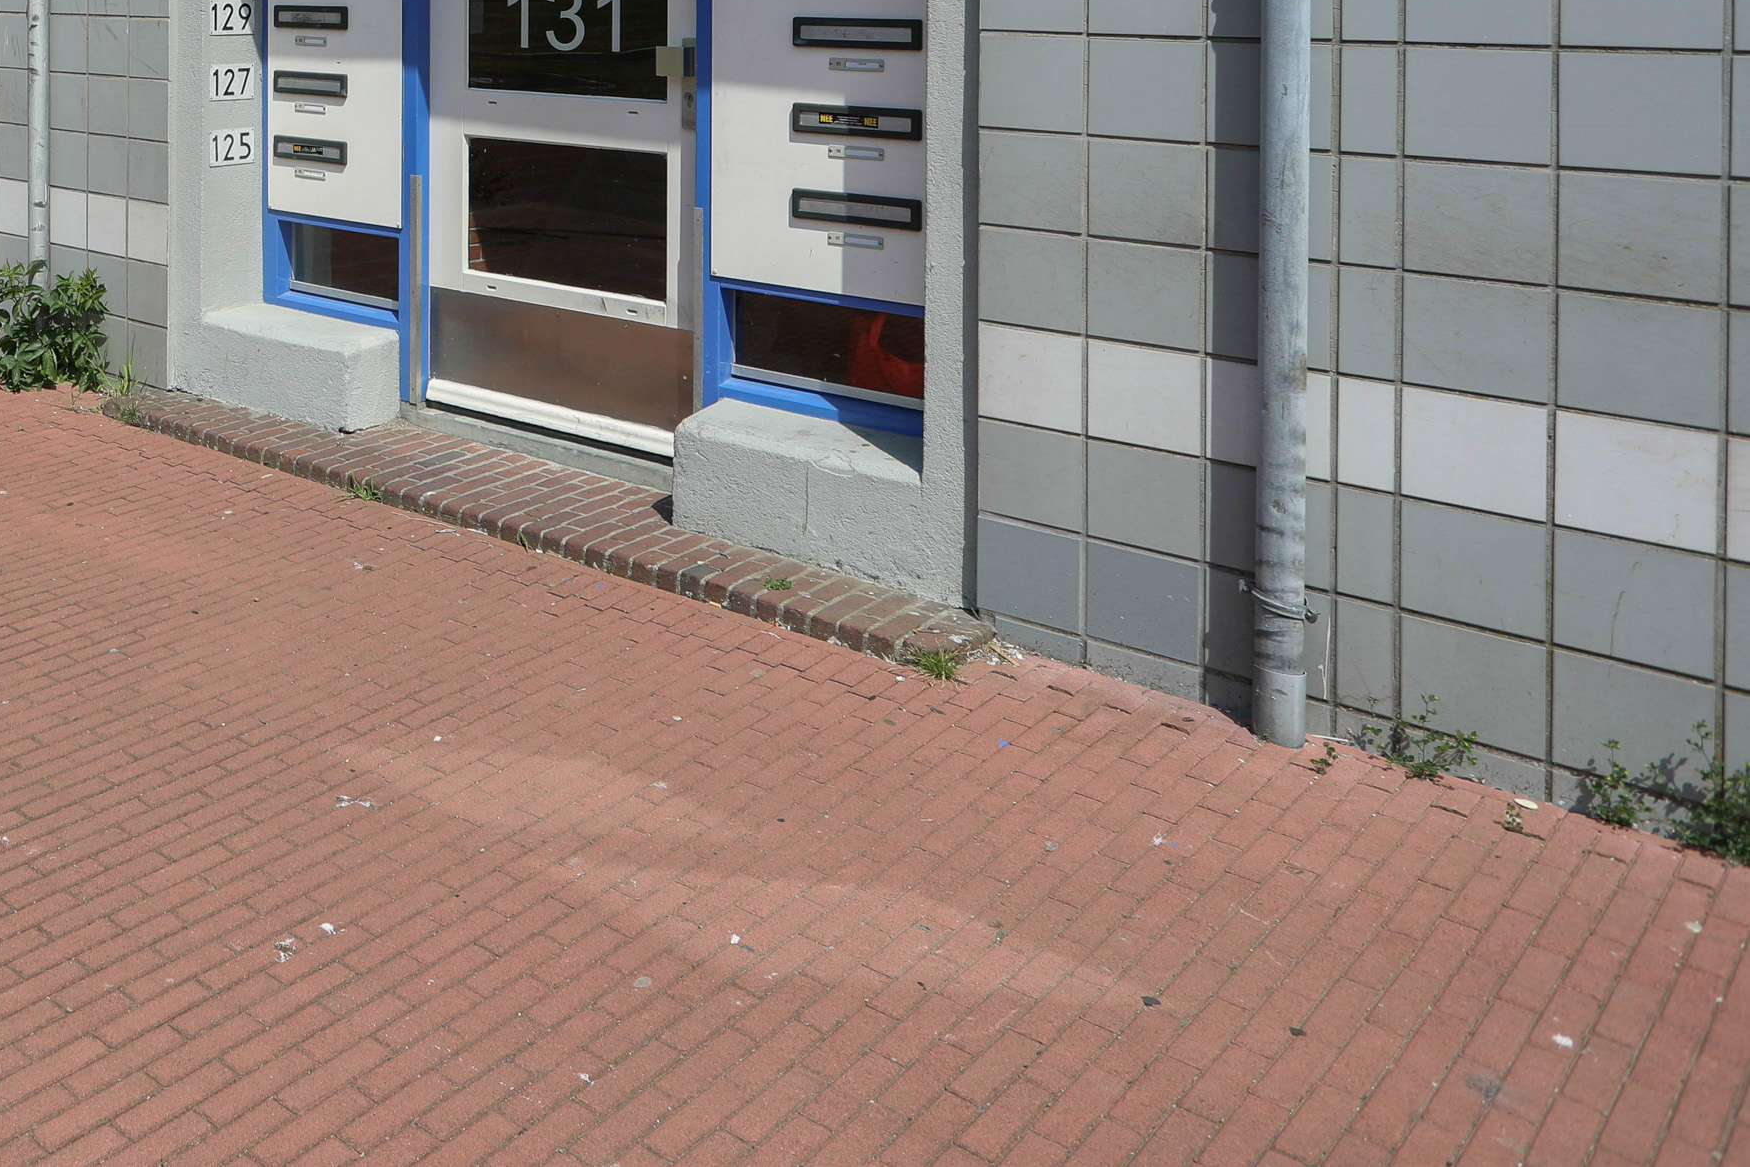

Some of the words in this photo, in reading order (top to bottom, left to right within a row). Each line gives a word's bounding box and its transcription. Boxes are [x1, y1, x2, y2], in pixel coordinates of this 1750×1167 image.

[211, 3, 252, 31] 129
[212, 68, 251, 96] 127
[820, 114, 833, 123] NEE
[863, 117, 878, 127] NEE
[212, 132, 251, 162] 125
